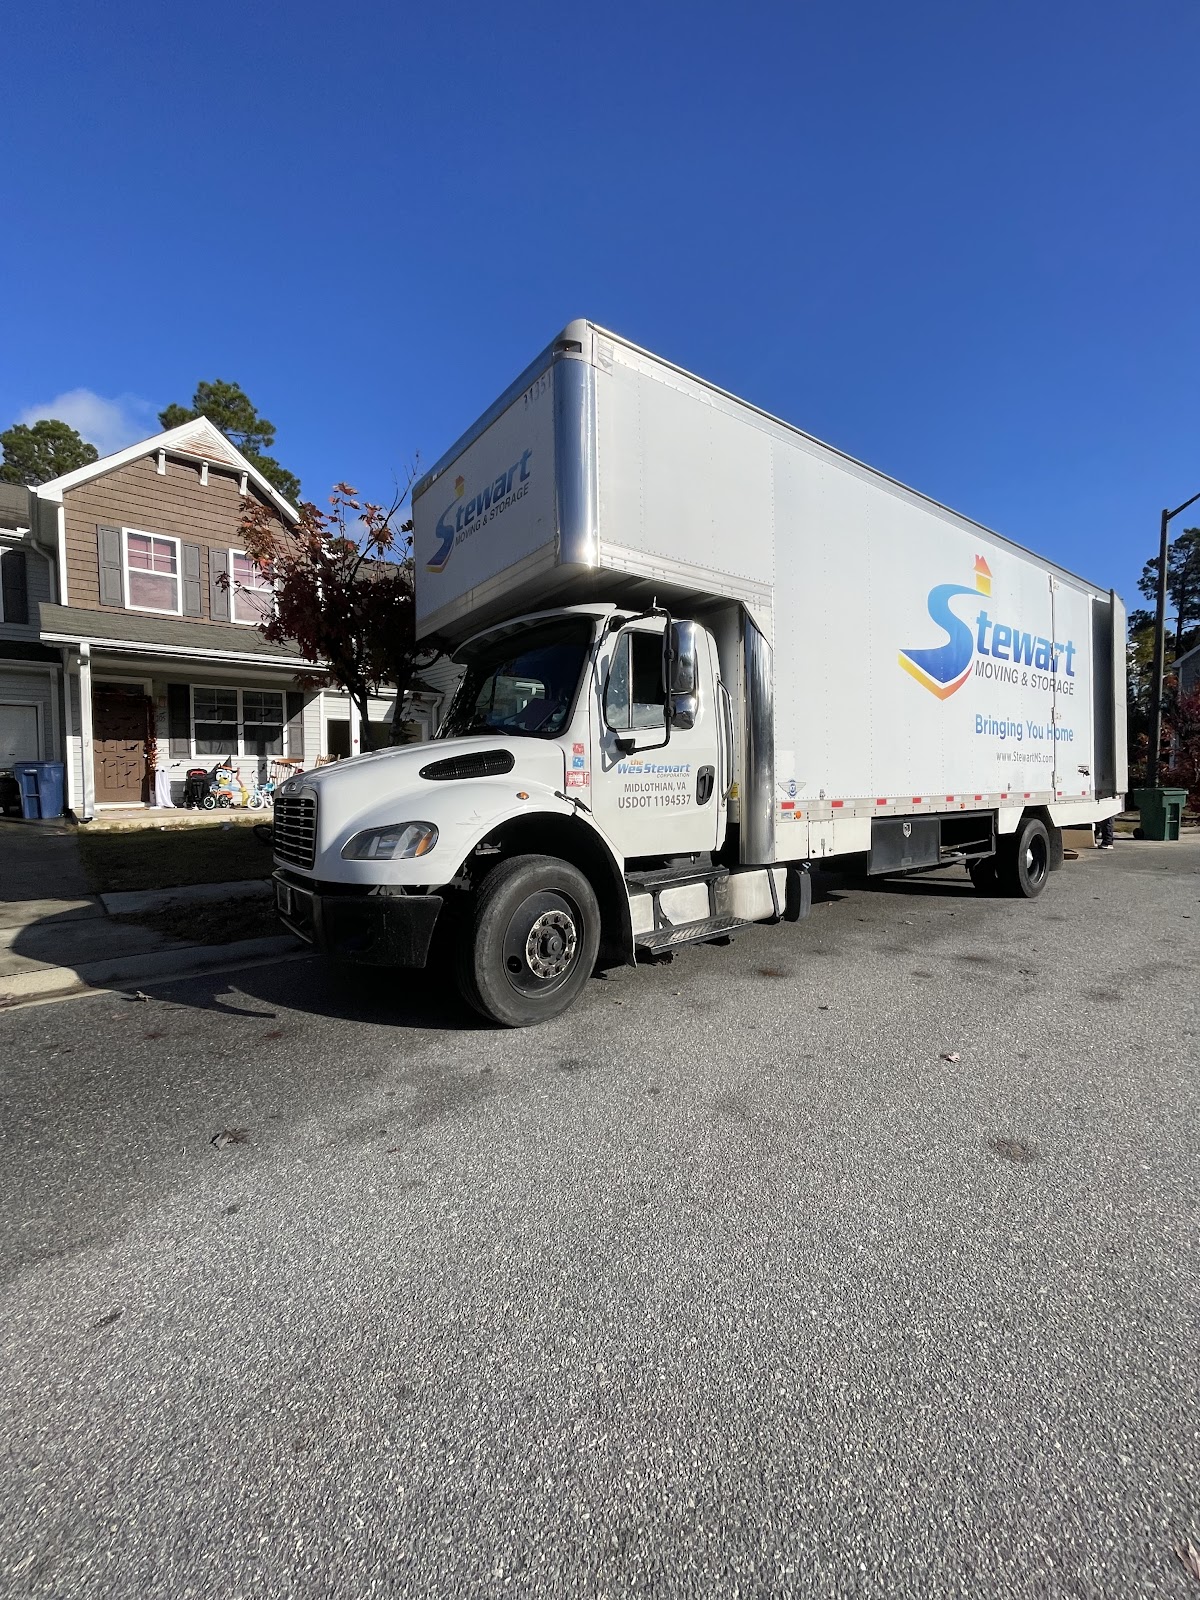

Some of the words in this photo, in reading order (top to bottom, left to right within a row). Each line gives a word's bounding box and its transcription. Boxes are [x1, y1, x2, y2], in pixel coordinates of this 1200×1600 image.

[426, 448, 533, 573] Stewart
[455, 520, 481, 547] MOVING
[482, 514, 488, 526] &
[489, 481, 530, 521] STORAGE
[898, 583, 1076, 701] Stewart
[975, 660, 1019, 684] MOVING
[1021, 671, 1028, 687] &
[1030, 674, 1075, 695] STORAGE
[975, 713, 1023, 742] Bringing
[1026, 720, 1044, 740] You
[1046, 721, 1074, 742] Home
[618, 795, 652, 809] USDOT
[654, 794, 691, 807] 1194537
[624, 782, 676, 793] MIDLOTHIAN,
[676, 781, 687, 791] VA
